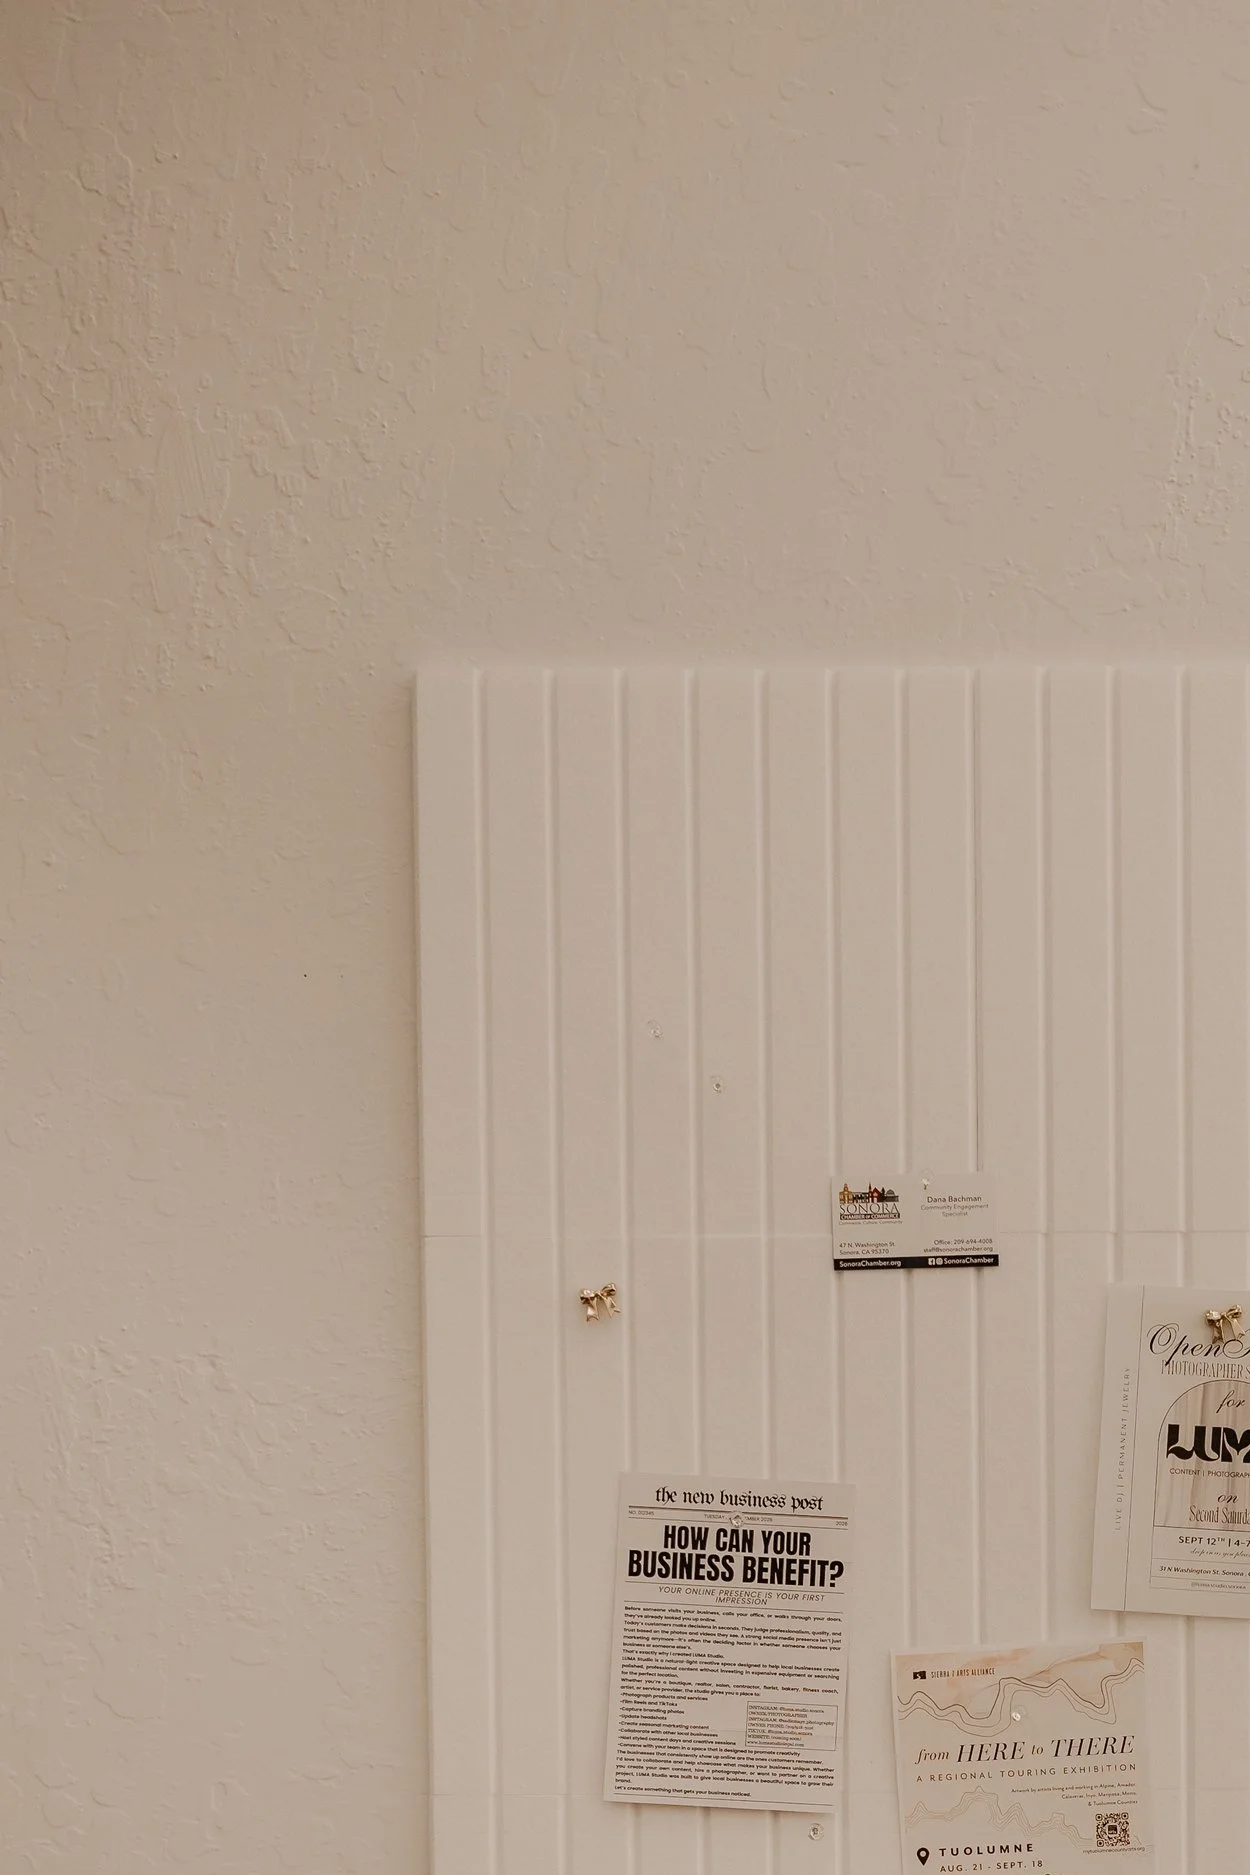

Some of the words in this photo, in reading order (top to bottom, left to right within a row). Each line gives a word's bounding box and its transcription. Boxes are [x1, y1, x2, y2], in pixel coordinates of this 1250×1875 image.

[840, 1203, 900, 1214] SONORA
[1147, 1323, 1222, 1366] Open
[1161, 1360, 1244, 1378] PHOTOGRAPHER
[1216, 1390, 1246, 1413] for
[1118, 1418, 1128, 1479] PERMANENT
[1170, 1468, 1200, 1476] CONTENT
[656, 1486, 677, 1505] the
[683, 1492, 714, 1504] new
[720, 1491, 786, 1508] business
[791, 1495, 823, 1512] post
[1117, 1493, 1124, 1502] DJ
[1218, 1494, 1239, 1503] on
[1189, 1505, 1219, 1522] Second
[664, 1525, 709, 1550] HOW
[715, 1528, 754, 1553] CAN
[761, 1531, 811, 1556] YOUR
[1178, 1536, 1203, 1544] SEPT
[628, 1550, 734, 1582] BUSINESS
[742, 1556, 844, 1587] BENEFIT?
[716, 1597, 768, 1606] IMPRESSION
[719, 1590, 762, 1598] PRESENCE
[915, 1748, 949, 1764] from
[957, 1742, 1025, 1762] HERE
[1032, 1744, 1043, 1755] to
[1051, 1735, 1134, 1757] THERE
[930, 1772, 992, 1781] REGIONAL
[1000, 1768, 1056, 1778] TOURING
[1064, 1764, 1136, 1774] EXHIBITION
[940, 1843, 1033, 1856] TUOLUMNE
[997, 1861, 1026, 1870] SEPT.
